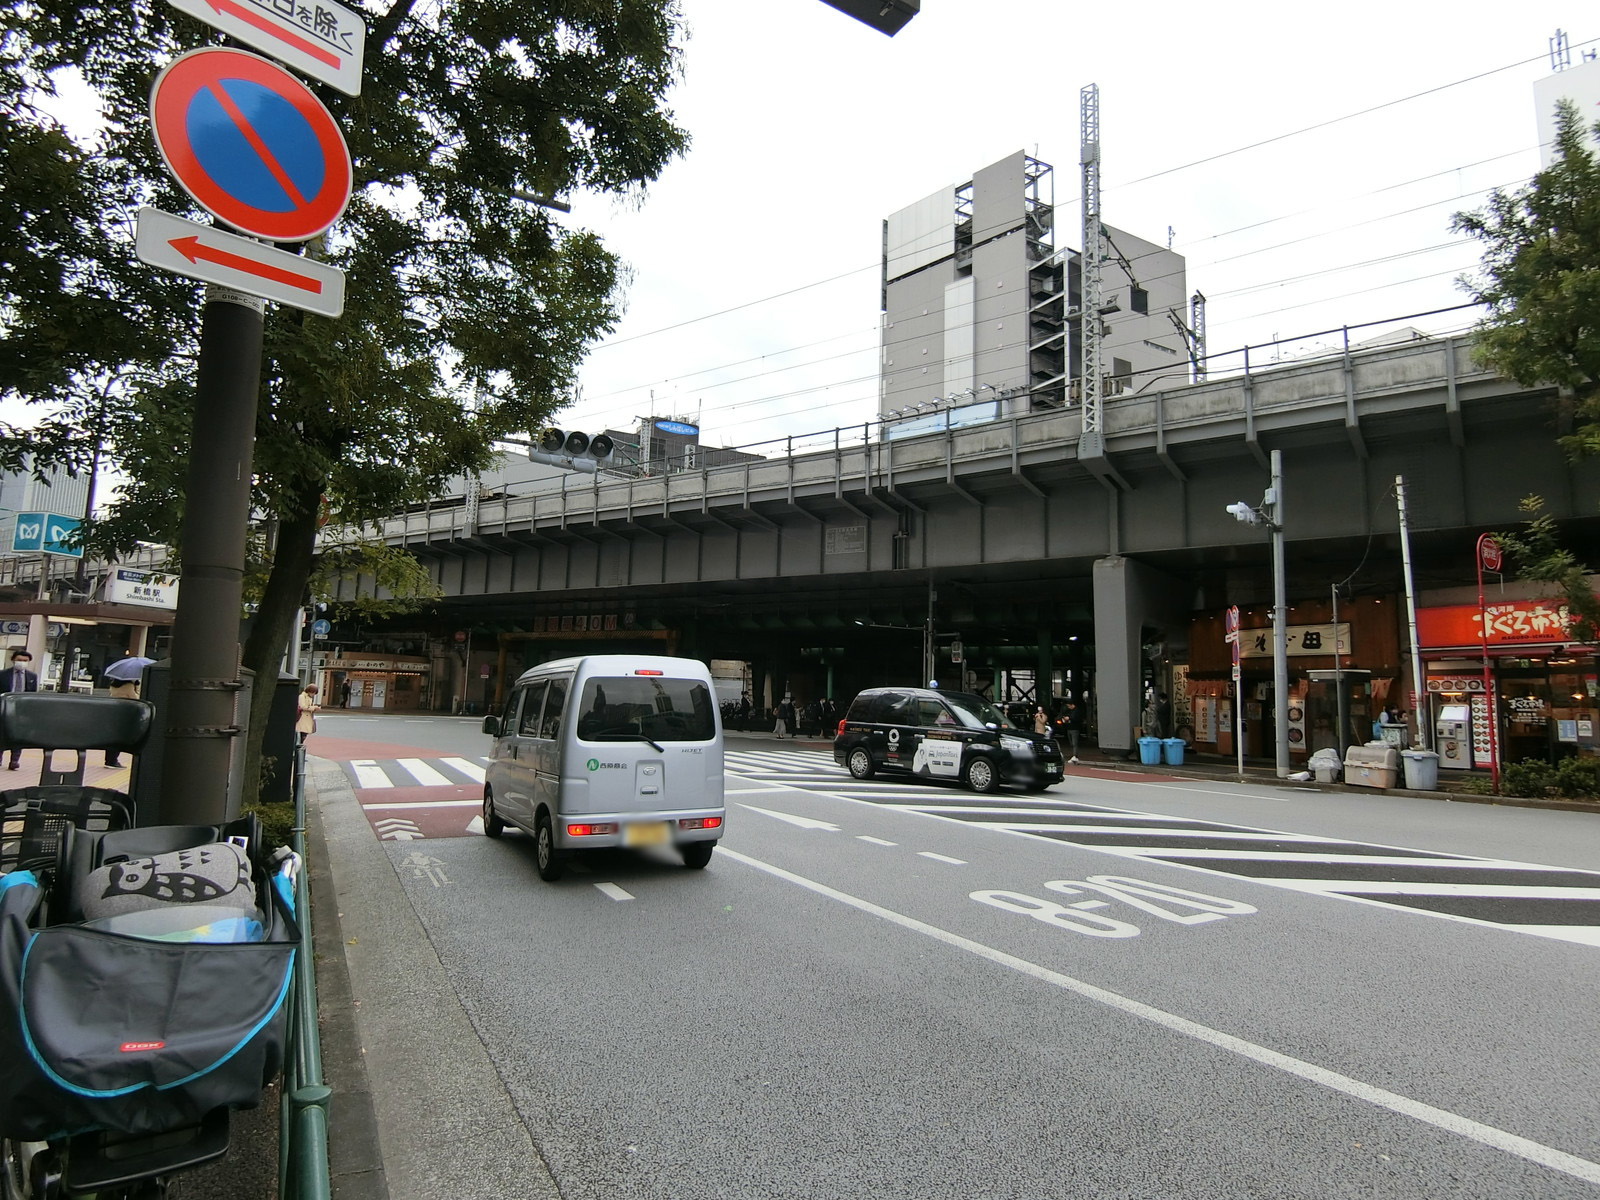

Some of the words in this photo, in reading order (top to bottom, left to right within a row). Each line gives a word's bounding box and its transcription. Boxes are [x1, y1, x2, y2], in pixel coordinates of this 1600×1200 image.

[265, 0, 354, 50] 日を除く
[126, 593, 155, 602] Shimbashi
[133, 586, 161, 598] 新橋駅
